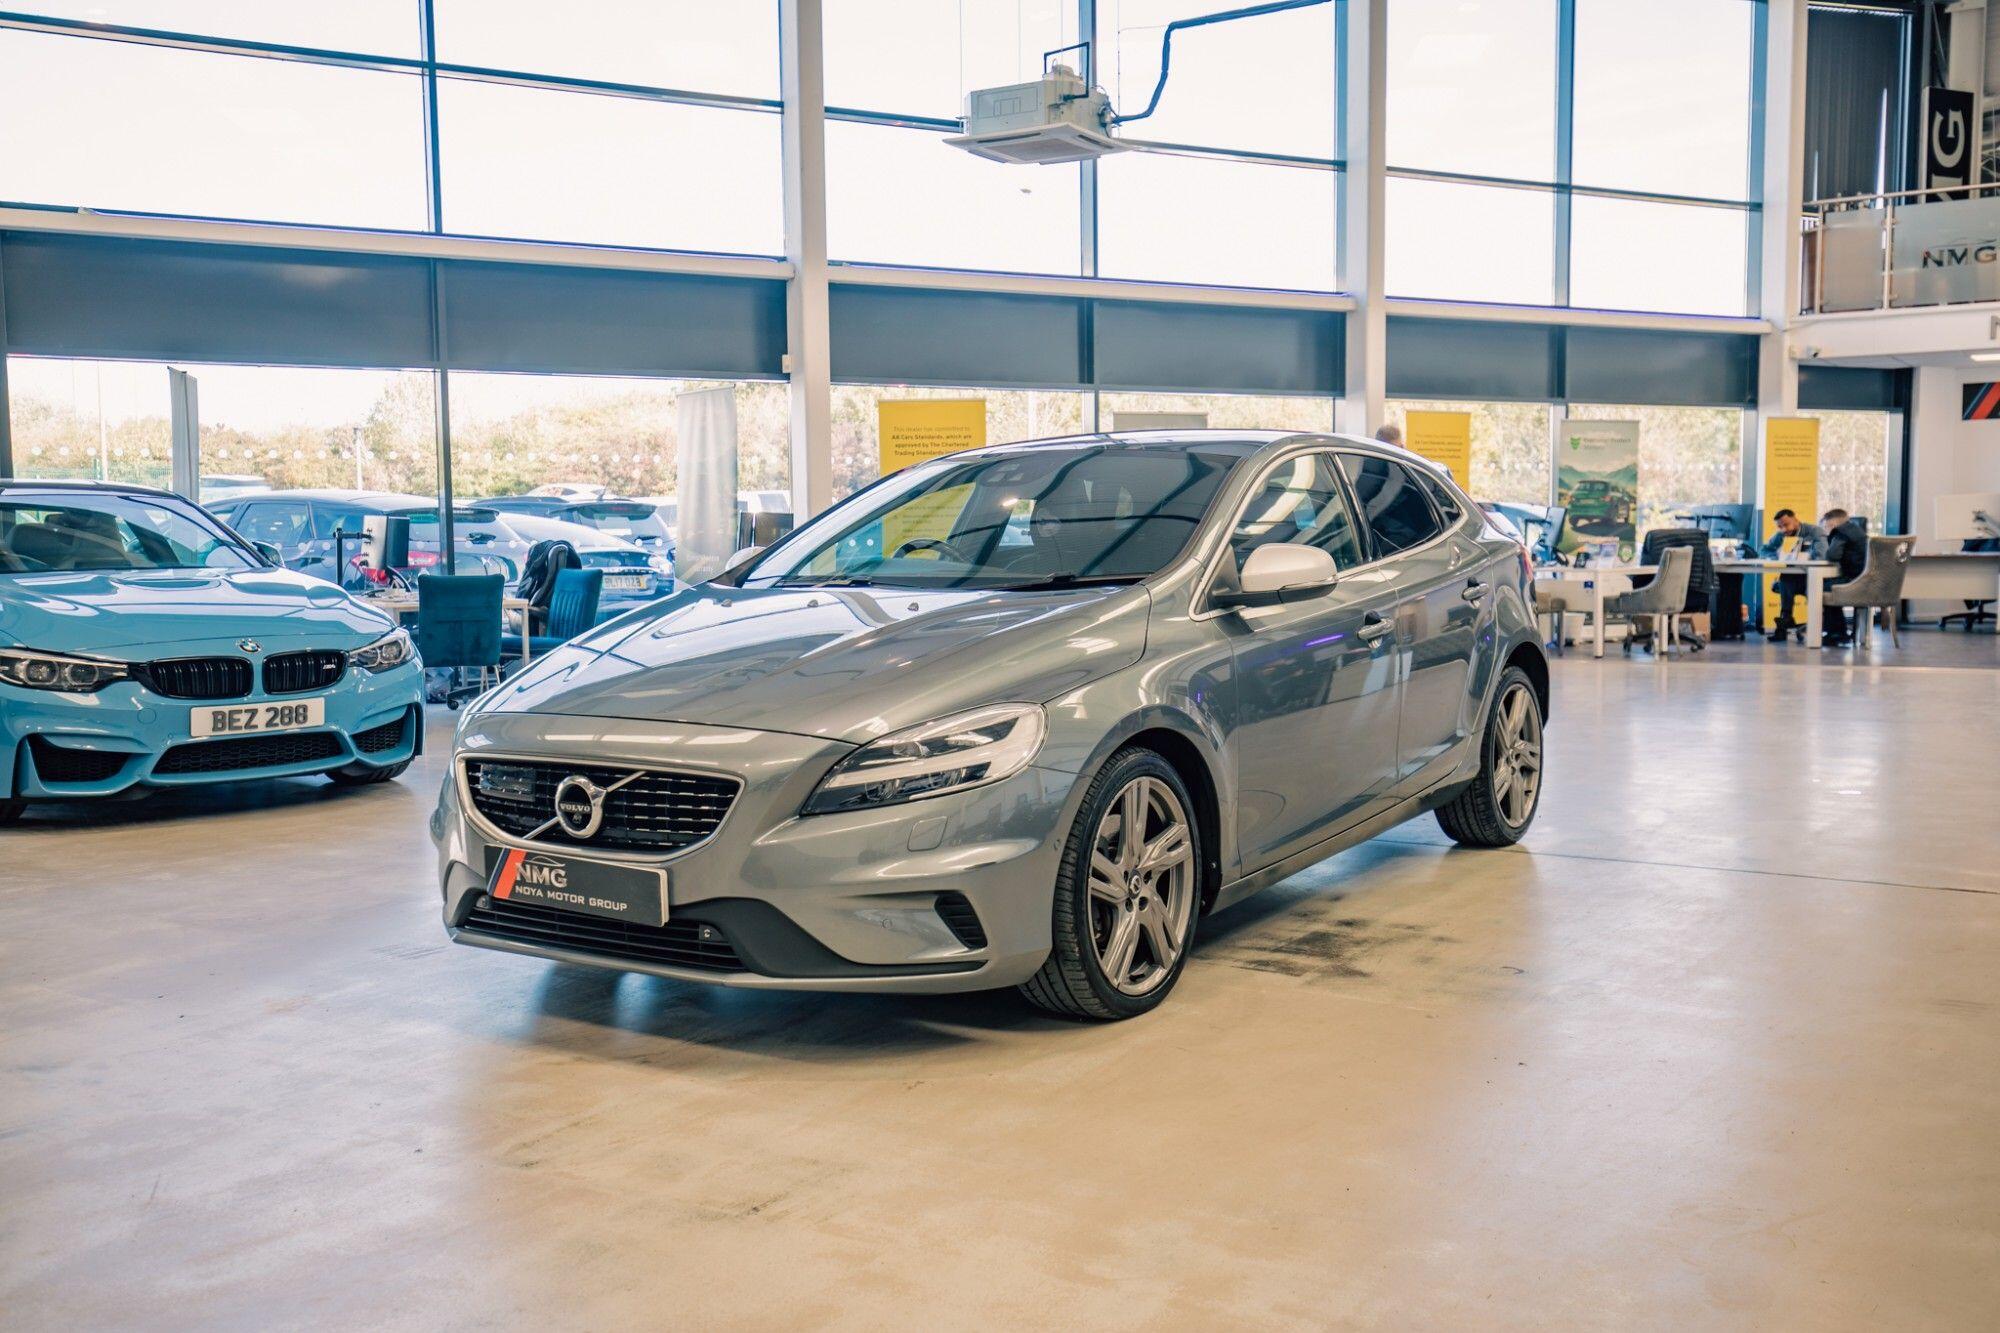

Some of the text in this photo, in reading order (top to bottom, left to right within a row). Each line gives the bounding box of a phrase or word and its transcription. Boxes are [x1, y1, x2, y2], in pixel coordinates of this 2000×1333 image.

[1922, 246, 1997, 268] NMG
[212, 704, 308, 732] BEZ 288
[559, 803, 591, 812] VOLVO
[515, 862, 567, 887] NMG
[547, 891, 585, 905] MOTOR
[589, 897, 628, 912] GROUP
